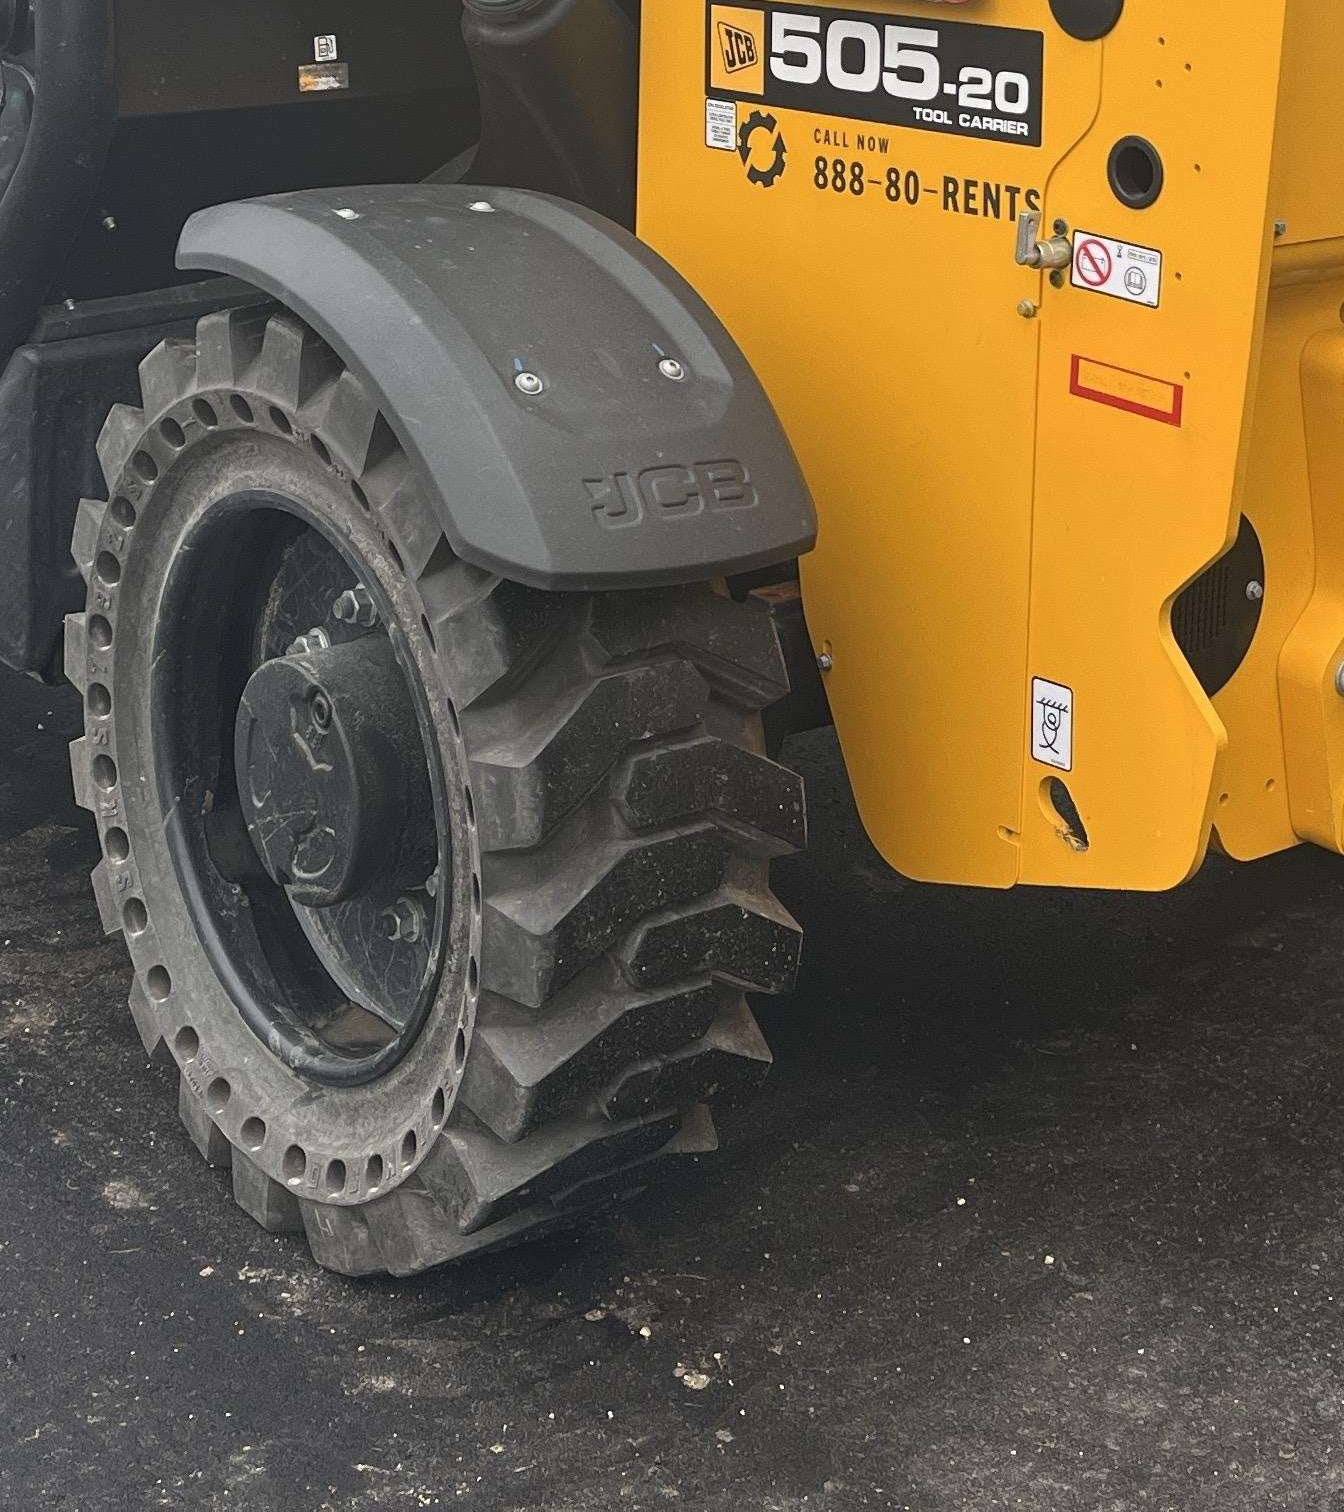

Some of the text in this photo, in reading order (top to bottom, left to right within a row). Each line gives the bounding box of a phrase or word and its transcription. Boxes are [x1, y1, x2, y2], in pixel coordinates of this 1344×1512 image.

[724, 27, 755, 68] JCB
[769, 11, 1030, 115] 505-20
[814, 127, 890, 155] CALL NOW
[913, 106, 1029, 136] TOOL CARRIER
[813, 155, 1041, 222] 888-80-RENTS
[582, 457, 759, 530] JCB
